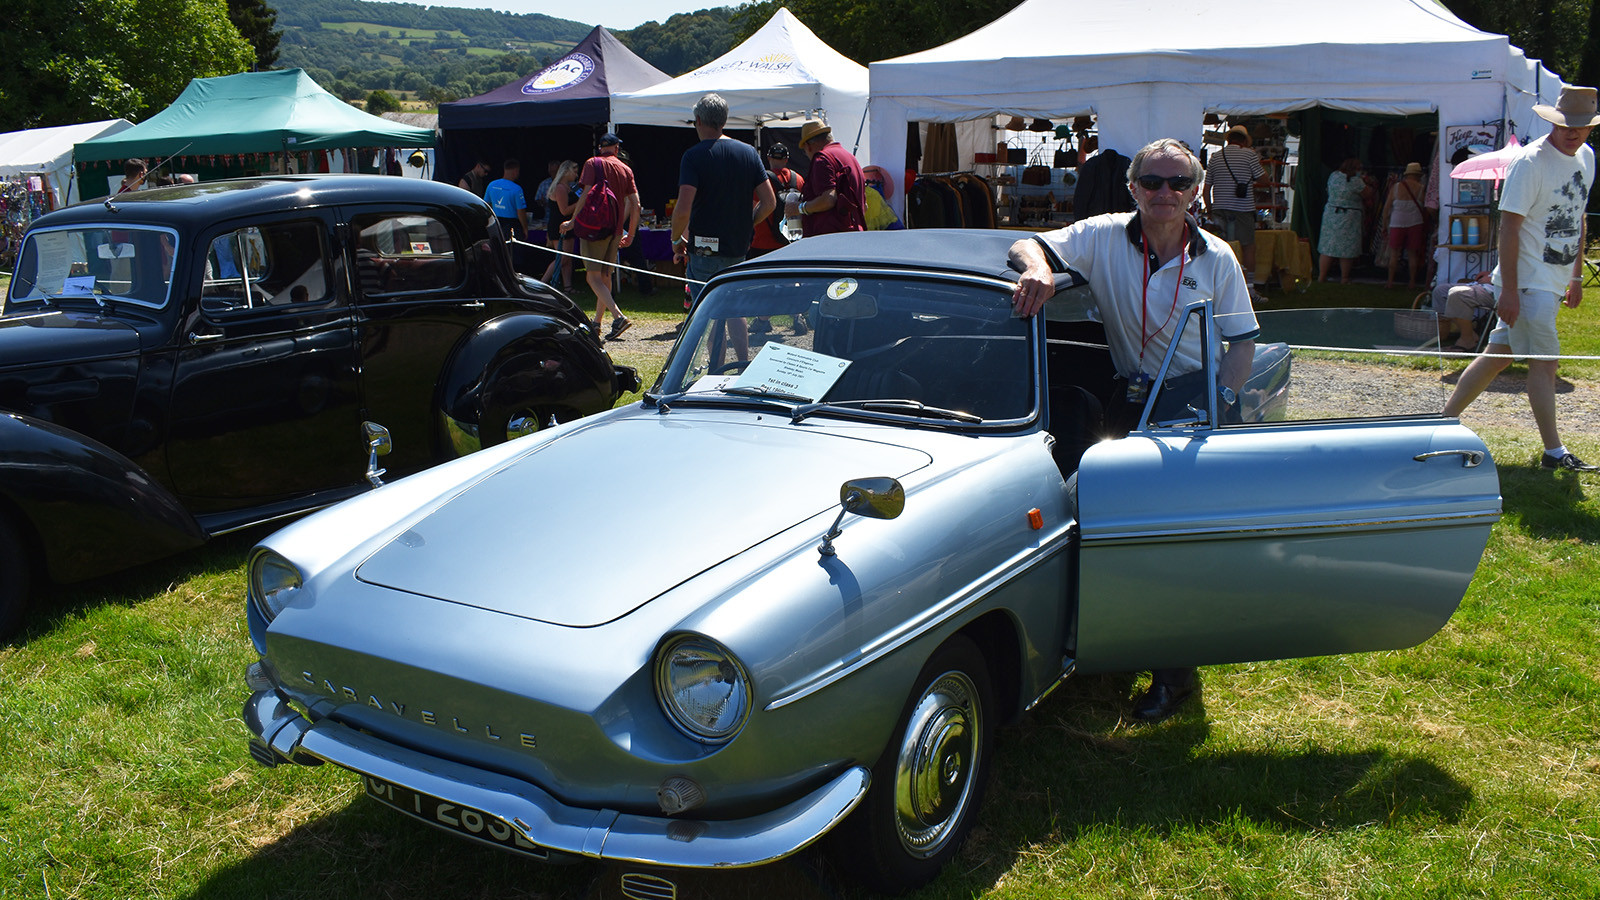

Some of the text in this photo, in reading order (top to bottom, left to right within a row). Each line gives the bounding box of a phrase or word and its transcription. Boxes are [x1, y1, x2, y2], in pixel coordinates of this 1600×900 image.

[749, 61, 794, 71] WALSH
[1449, 129, 1473, 145] Keep
[303, 671, 537, 748] CARAVELLE
